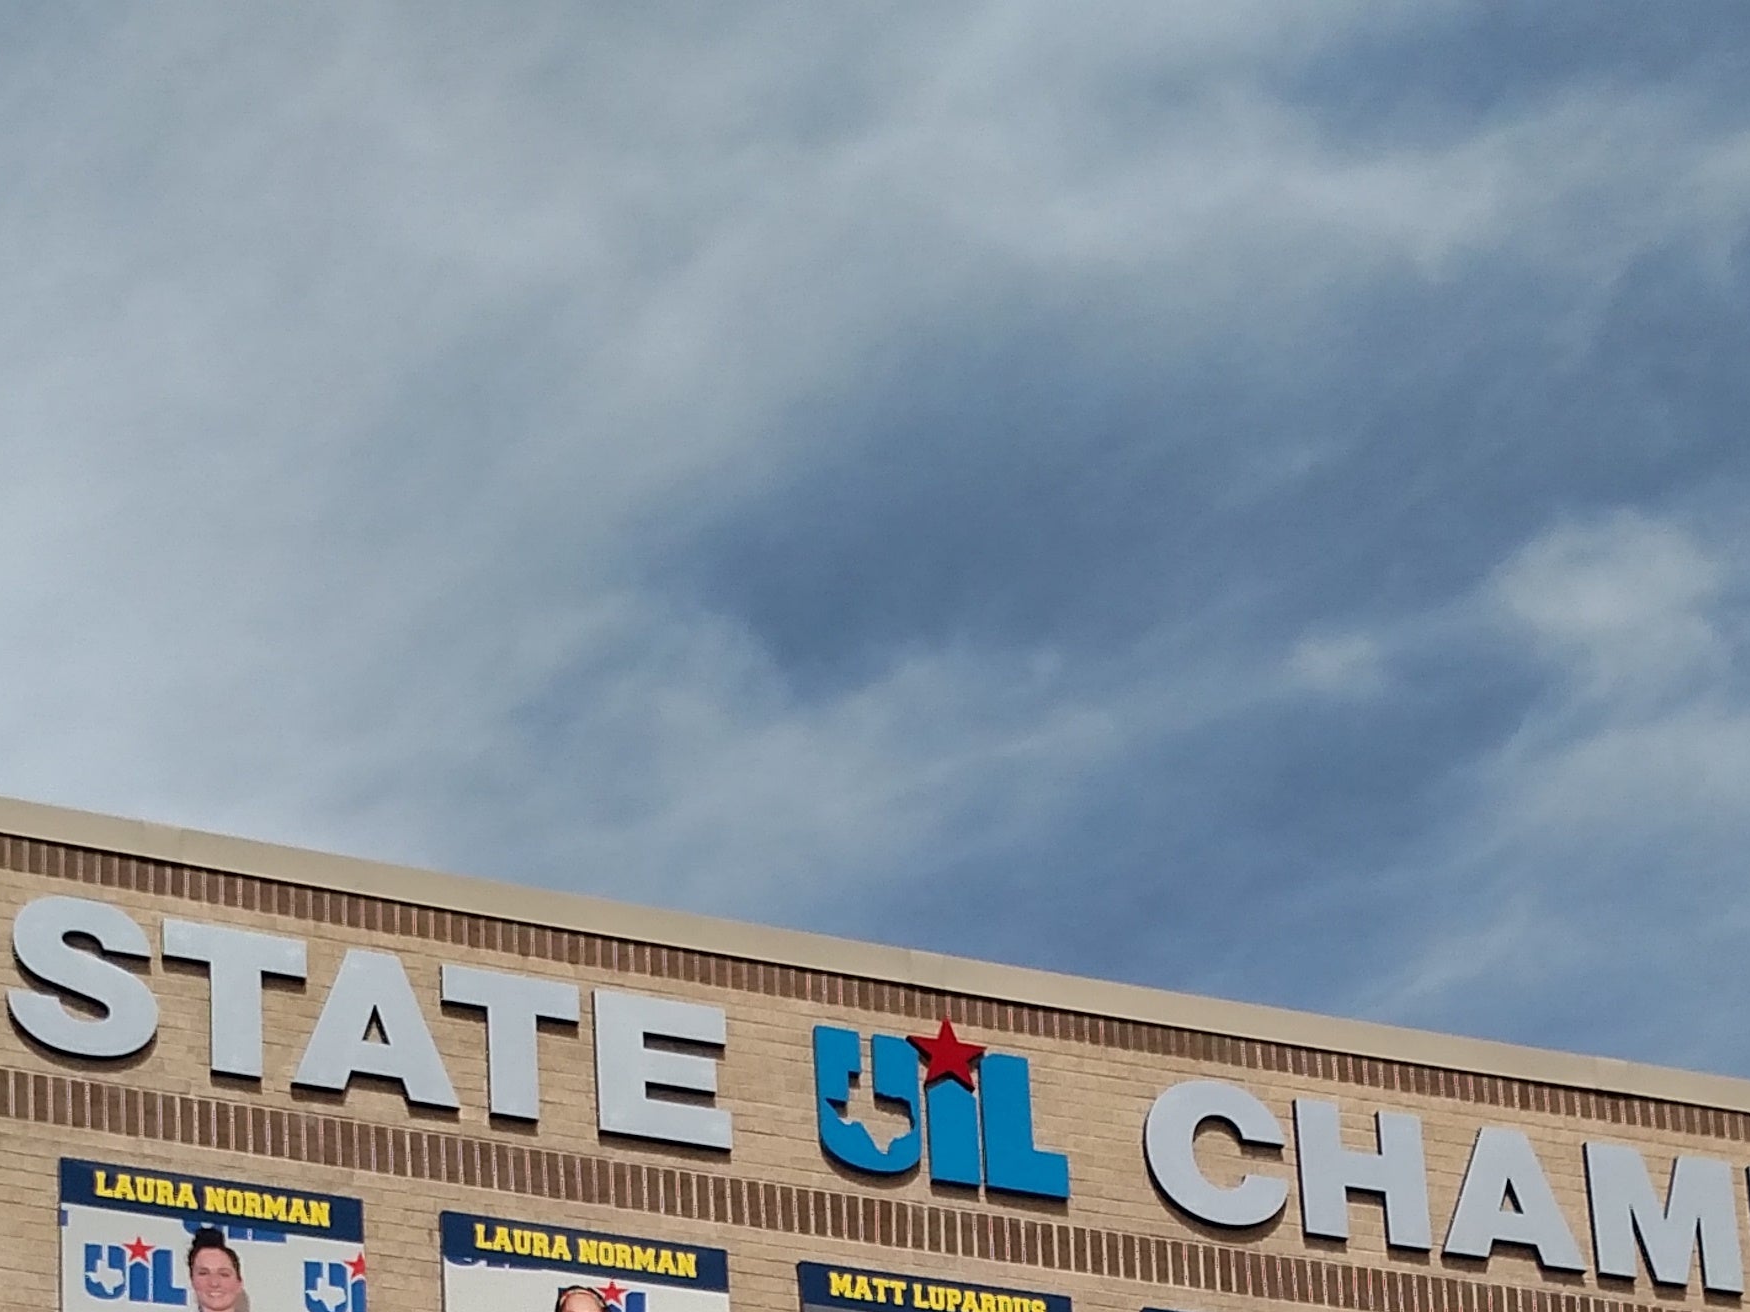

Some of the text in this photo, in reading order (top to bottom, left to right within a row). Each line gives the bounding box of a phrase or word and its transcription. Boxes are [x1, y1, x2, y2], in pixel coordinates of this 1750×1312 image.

[8, 895, 732, 1151] STATE
[95, 1172, 330, 1226] LAURA NORMAN
[475, 1224, 696, 1277] LAURA NORMAN
[829, 1273, 905, 1304] MATT
